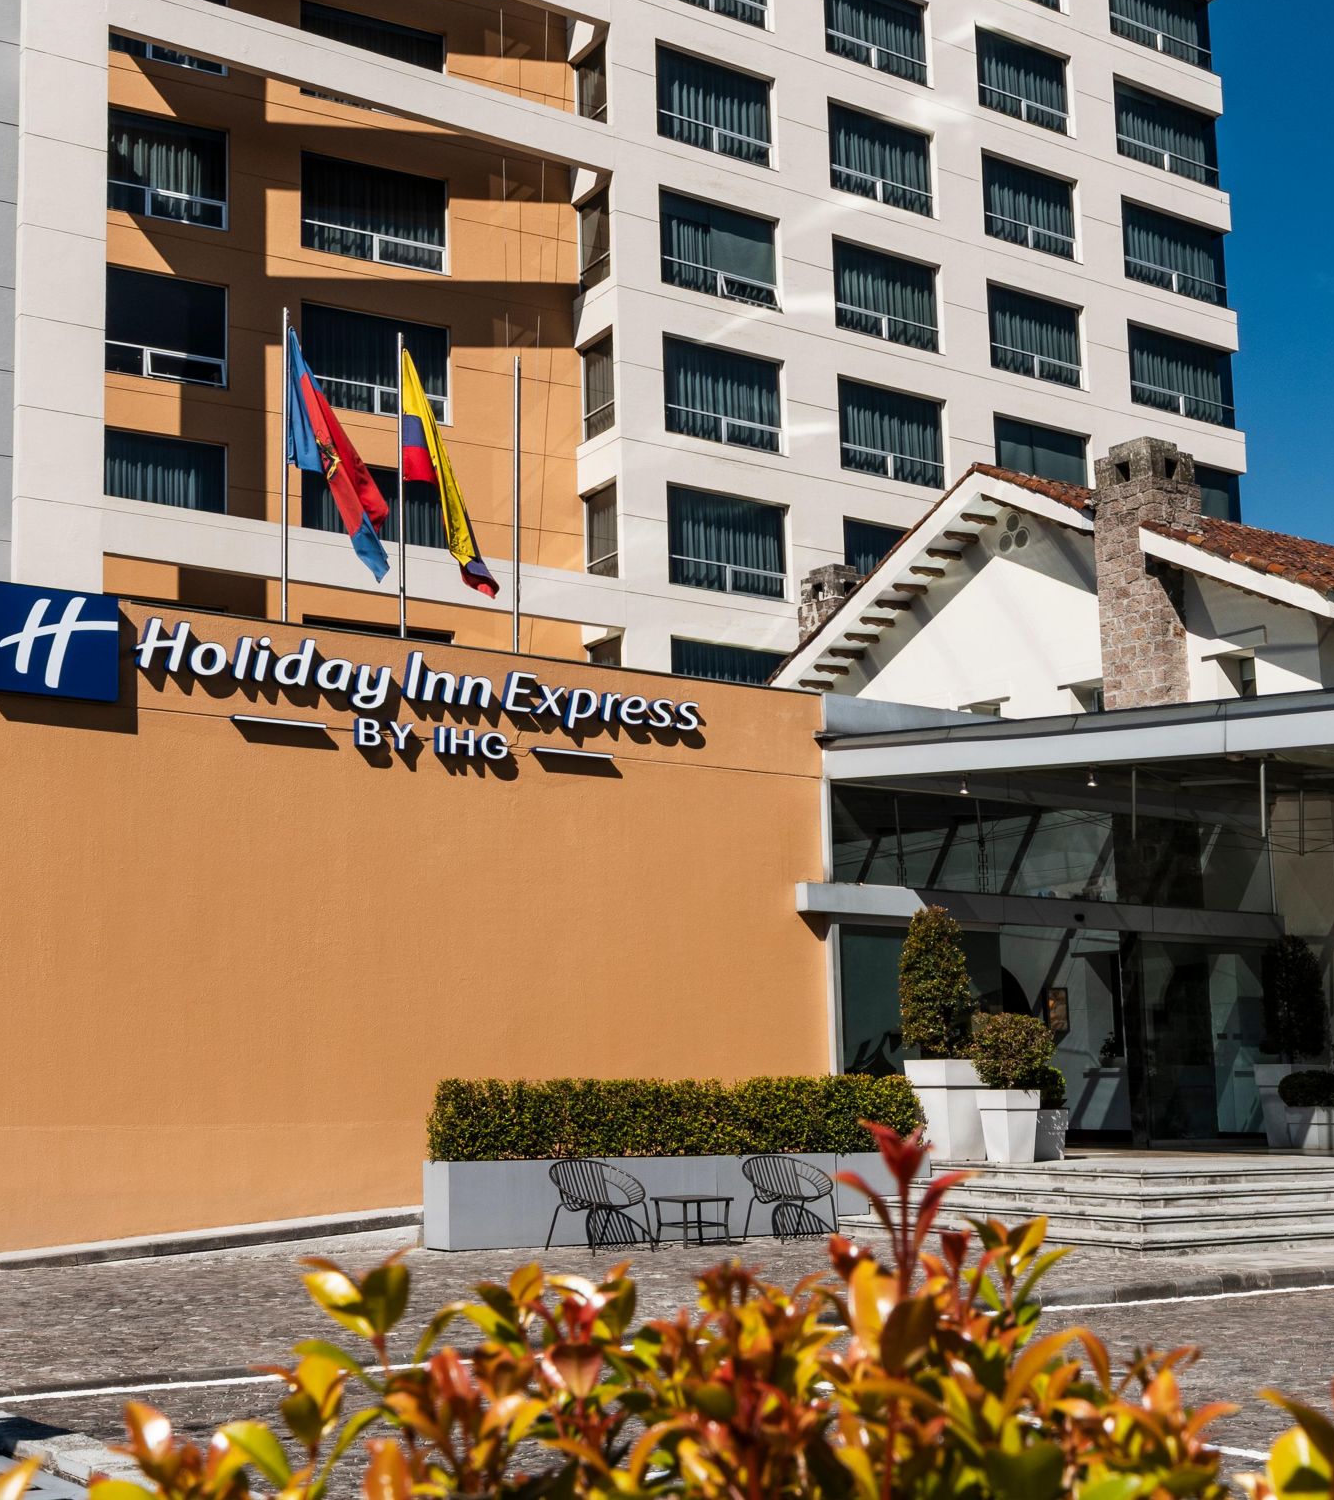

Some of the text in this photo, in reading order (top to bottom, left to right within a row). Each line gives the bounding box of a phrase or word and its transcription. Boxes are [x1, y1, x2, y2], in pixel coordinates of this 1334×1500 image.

[134, 616, 700, 731] Holiday Inn Express
[354, 717, 509, 760] BY IHG
